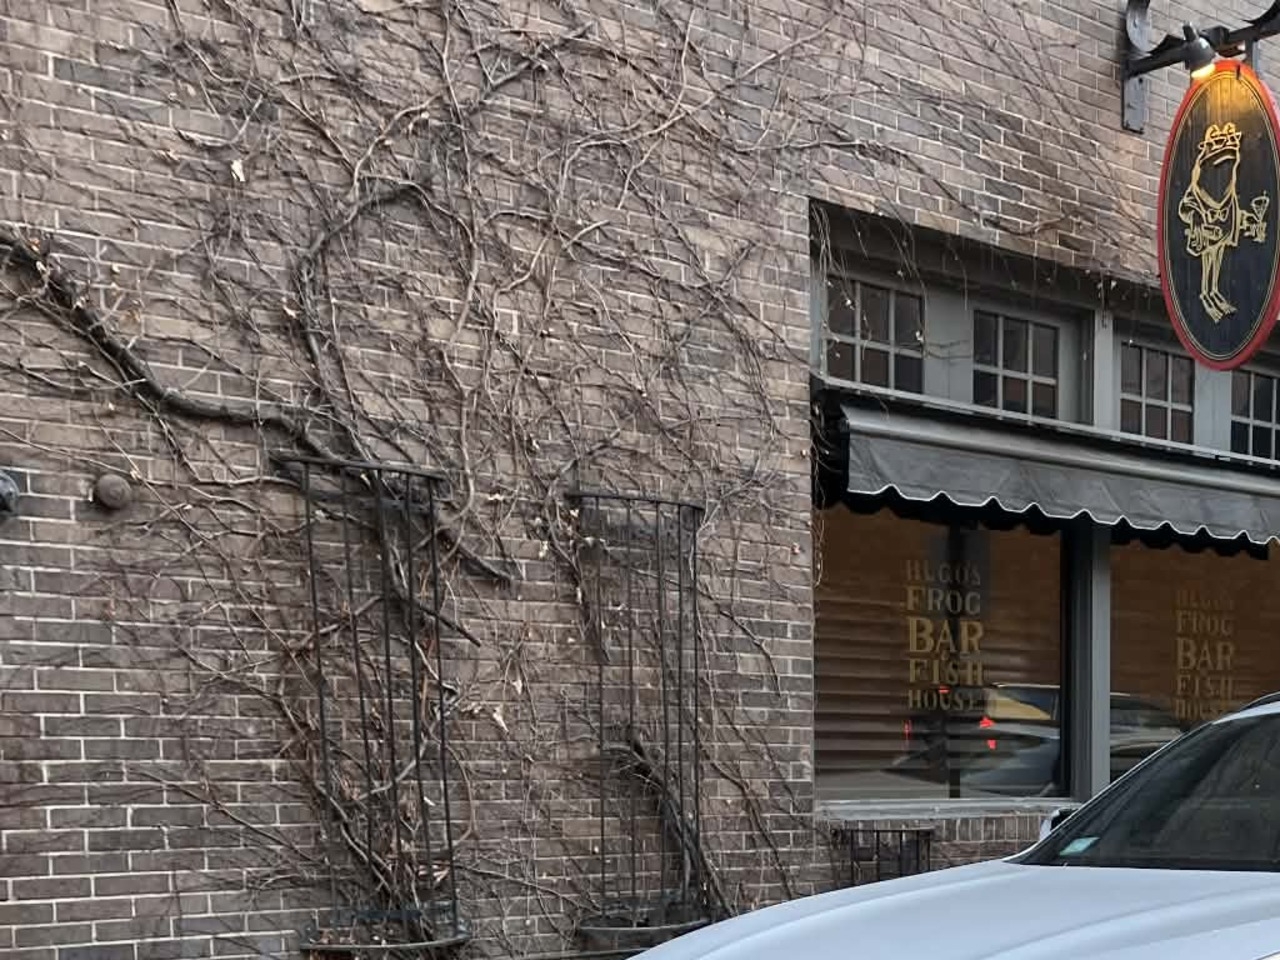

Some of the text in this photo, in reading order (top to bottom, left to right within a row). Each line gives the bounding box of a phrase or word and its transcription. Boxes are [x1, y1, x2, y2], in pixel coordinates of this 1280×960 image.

[908, 615, 984, 655] BAR
[1175, 636, 1236, 672] BAR
[909, 658, 984, 687] FISH
